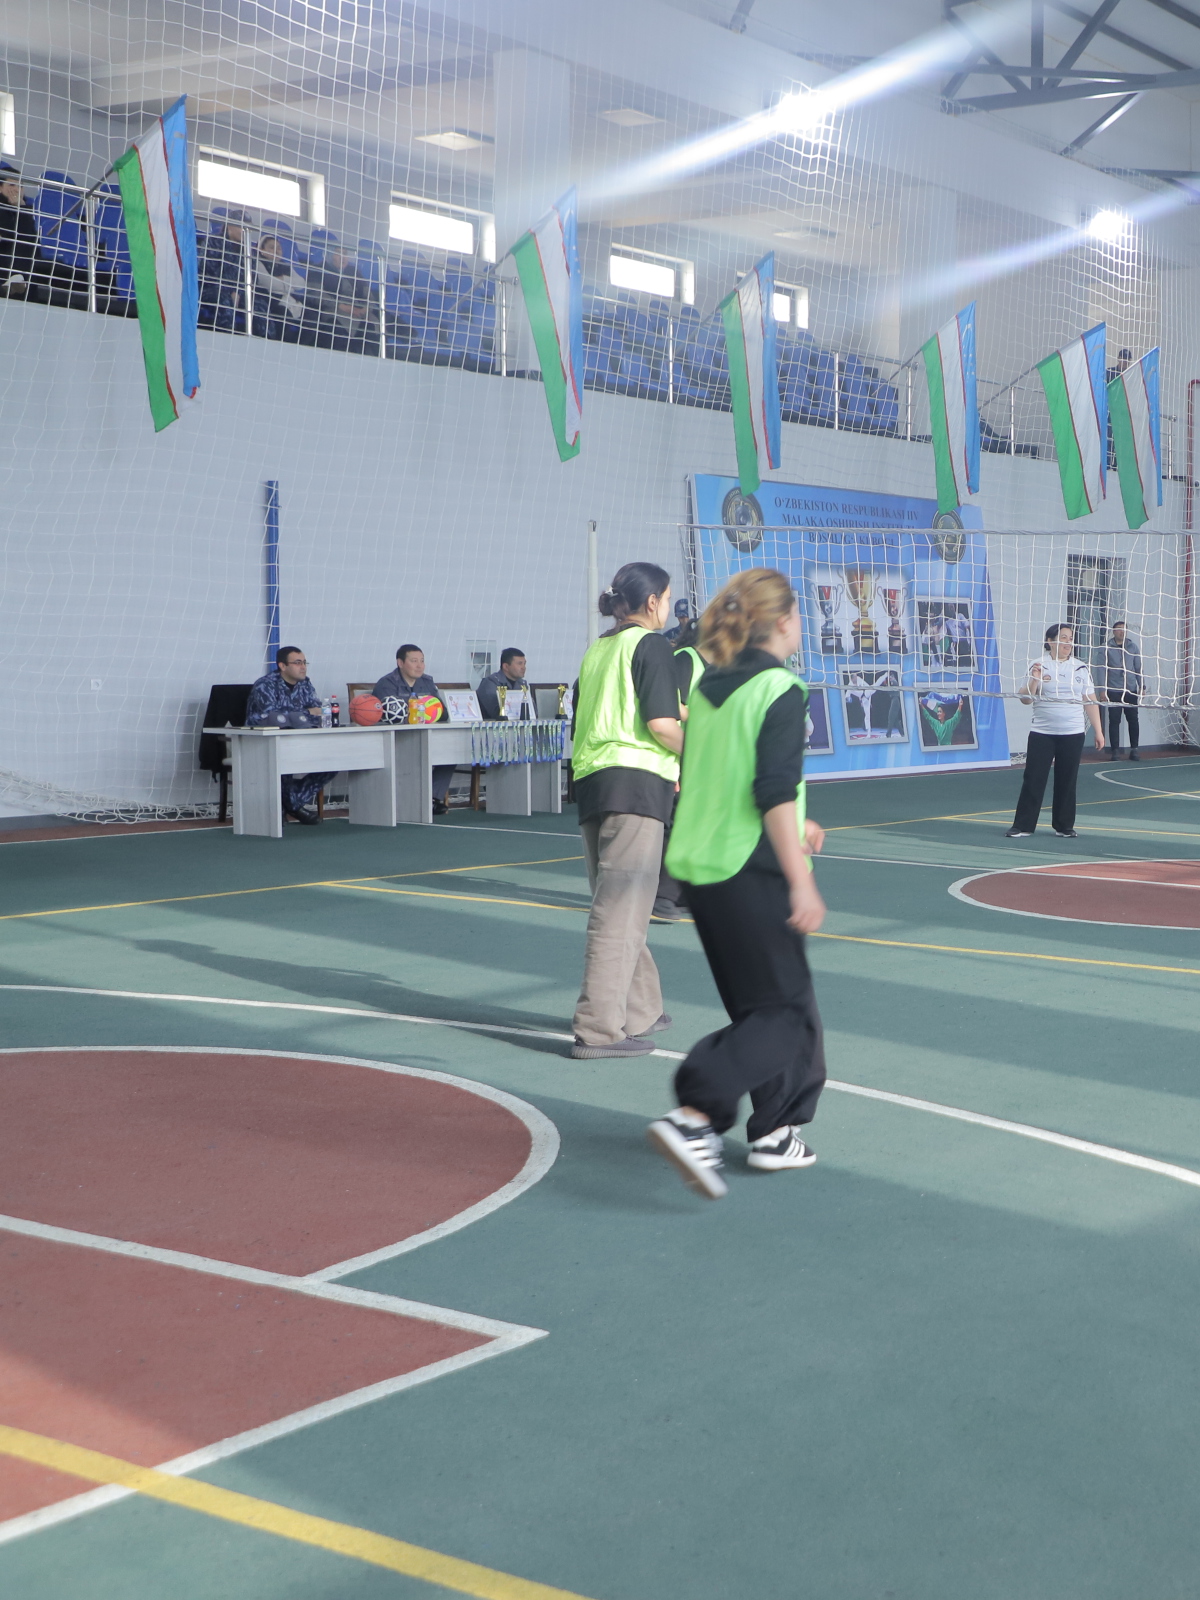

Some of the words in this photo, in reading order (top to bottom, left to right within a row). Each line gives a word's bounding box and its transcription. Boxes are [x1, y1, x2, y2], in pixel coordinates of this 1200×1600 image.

[774, 496, 839, 512] O‘ZBEKISTON
[841, 503, 905, 519] RESPUBLIKASI
[907, 510, 919, 521] IIV
[782, 514, 824, 527] MALAKA
[826, 518, 870, 529] OSHIRISH
